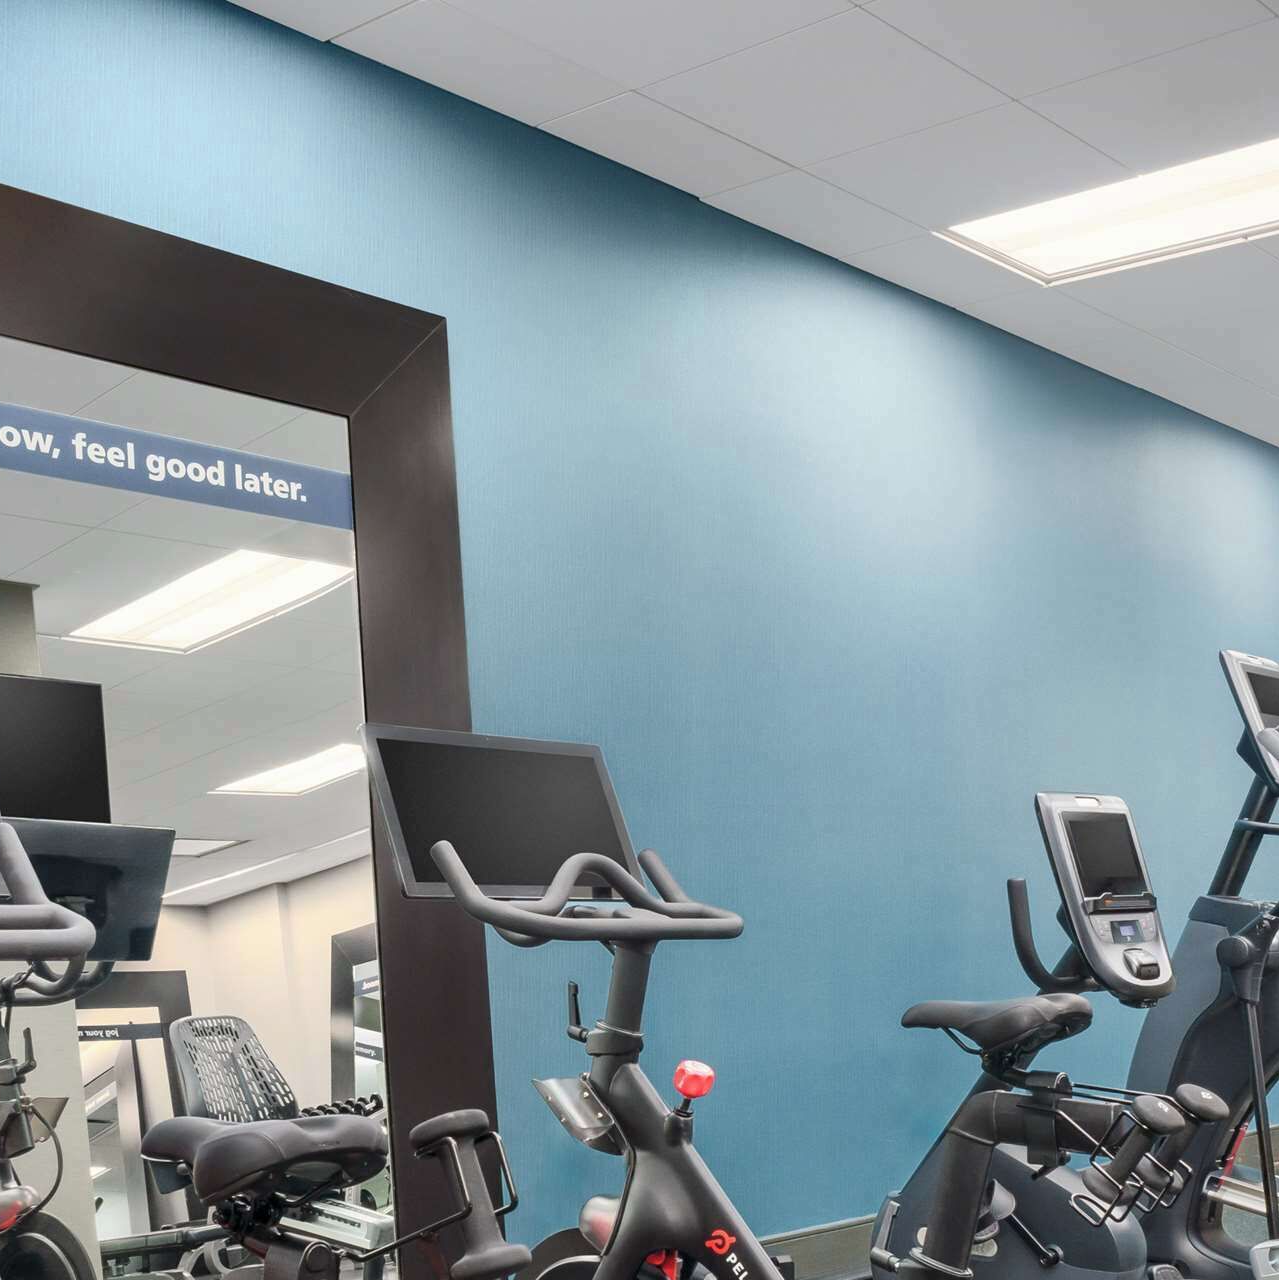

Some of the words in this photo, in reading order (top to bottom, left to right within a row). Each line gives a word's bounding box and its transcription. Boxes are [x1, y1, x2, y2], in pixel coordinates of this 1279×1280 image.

[71, 432, 136, 470] feel
[145, 454, 226, 487] good
[234, 463, 308, 503] later.
